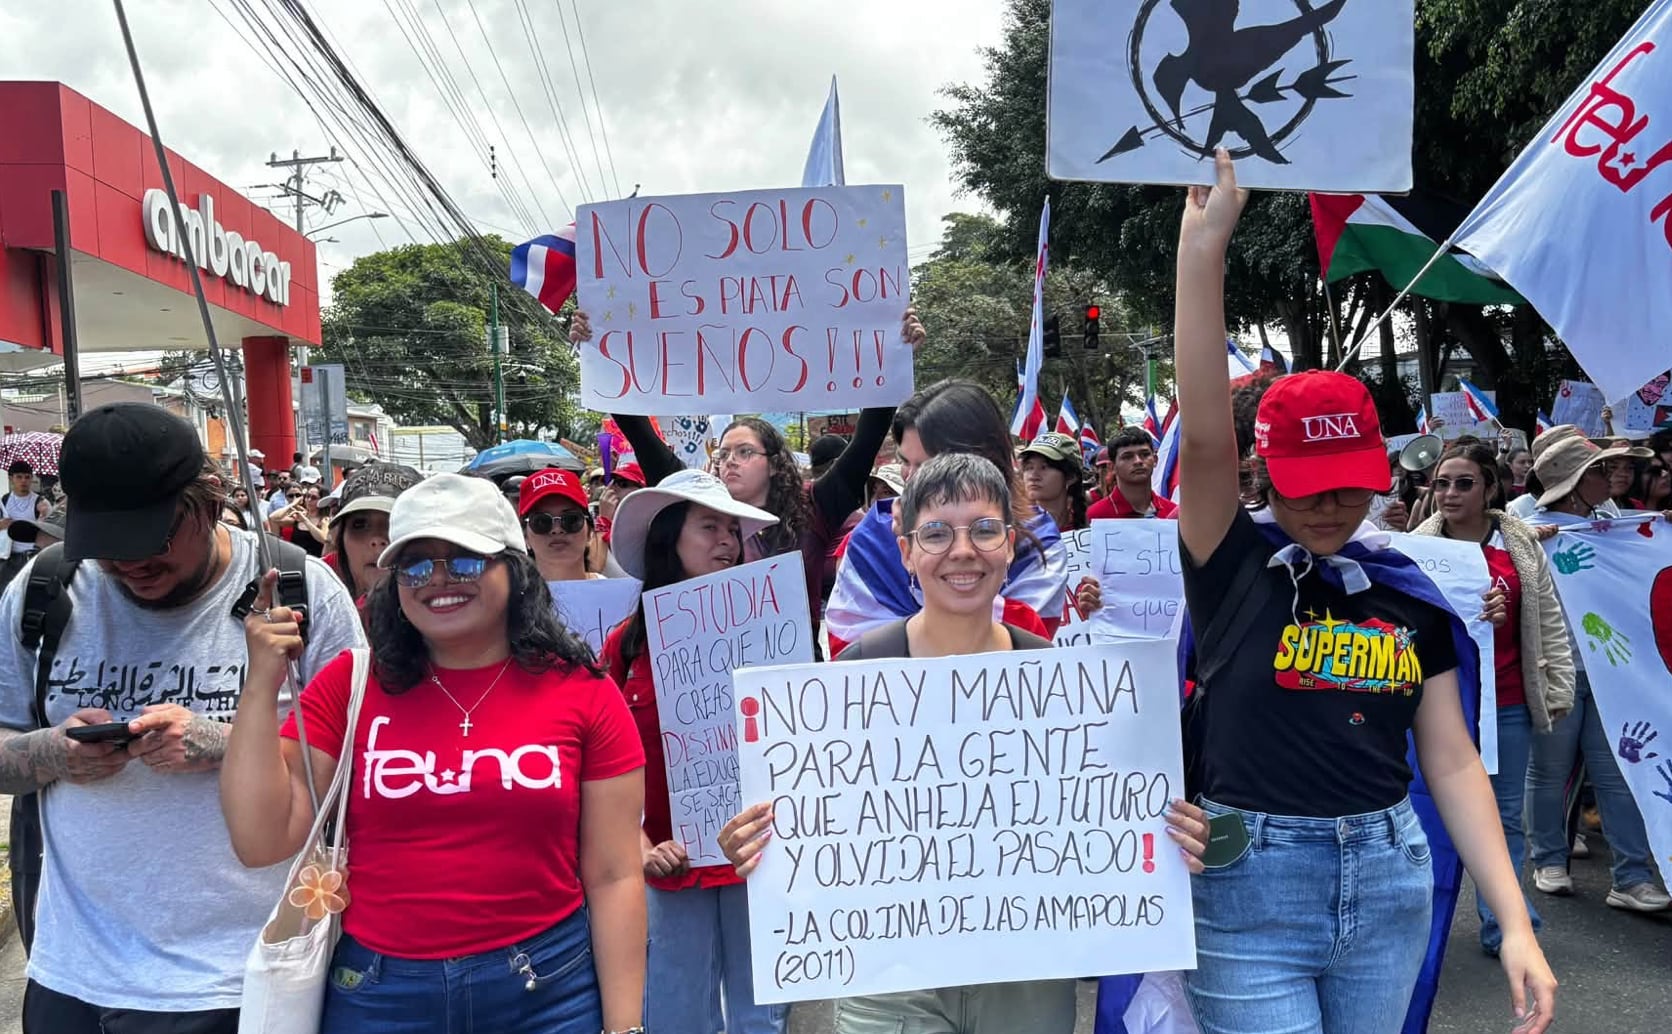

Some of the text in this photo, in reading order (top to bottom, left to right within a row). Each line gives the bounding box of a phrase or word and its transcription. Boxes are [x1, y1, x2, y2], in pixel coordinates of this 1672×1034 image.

[142, 188, 291, 306] ambacar
[592, 198, 838, 279] NO SOLO
[649, 265, 900, 319] ES PLATA SON
[1302, 415, 1360, 440] UNA
[532, 474, 567, 491] UNA
[654, 564, 779, 650] ESTUDIÁ
[656, 619, 797, 696] PARA QUE NO
[1273, 624, 1422, 685] SUPERMAN
[675, 682, 732, 724] CREAS
[844, 669, 926, 730] HAY
[952, 659, 1139, 724] MAÑANA
[363, 716, 562, 799] feuna
[670, 767, 692, 793] LA
[763, 721, 1108, 791] PARA LA GENTE
[681, 792, 702, 816] SE
[772, 772, 1170, 840] QUE ANHELA EL FUTURO
[785, 829, 1155, 893] Y OLVIDA EL PASADO!
[830, 898, 933, 941] COLINA
[938, 895, 976, 935] DE
[983, 895, 1028, 931] LAS
[1034, 894, 1164, 932] AMAPOLAS
[774, 945, 855, 989] (2011)
